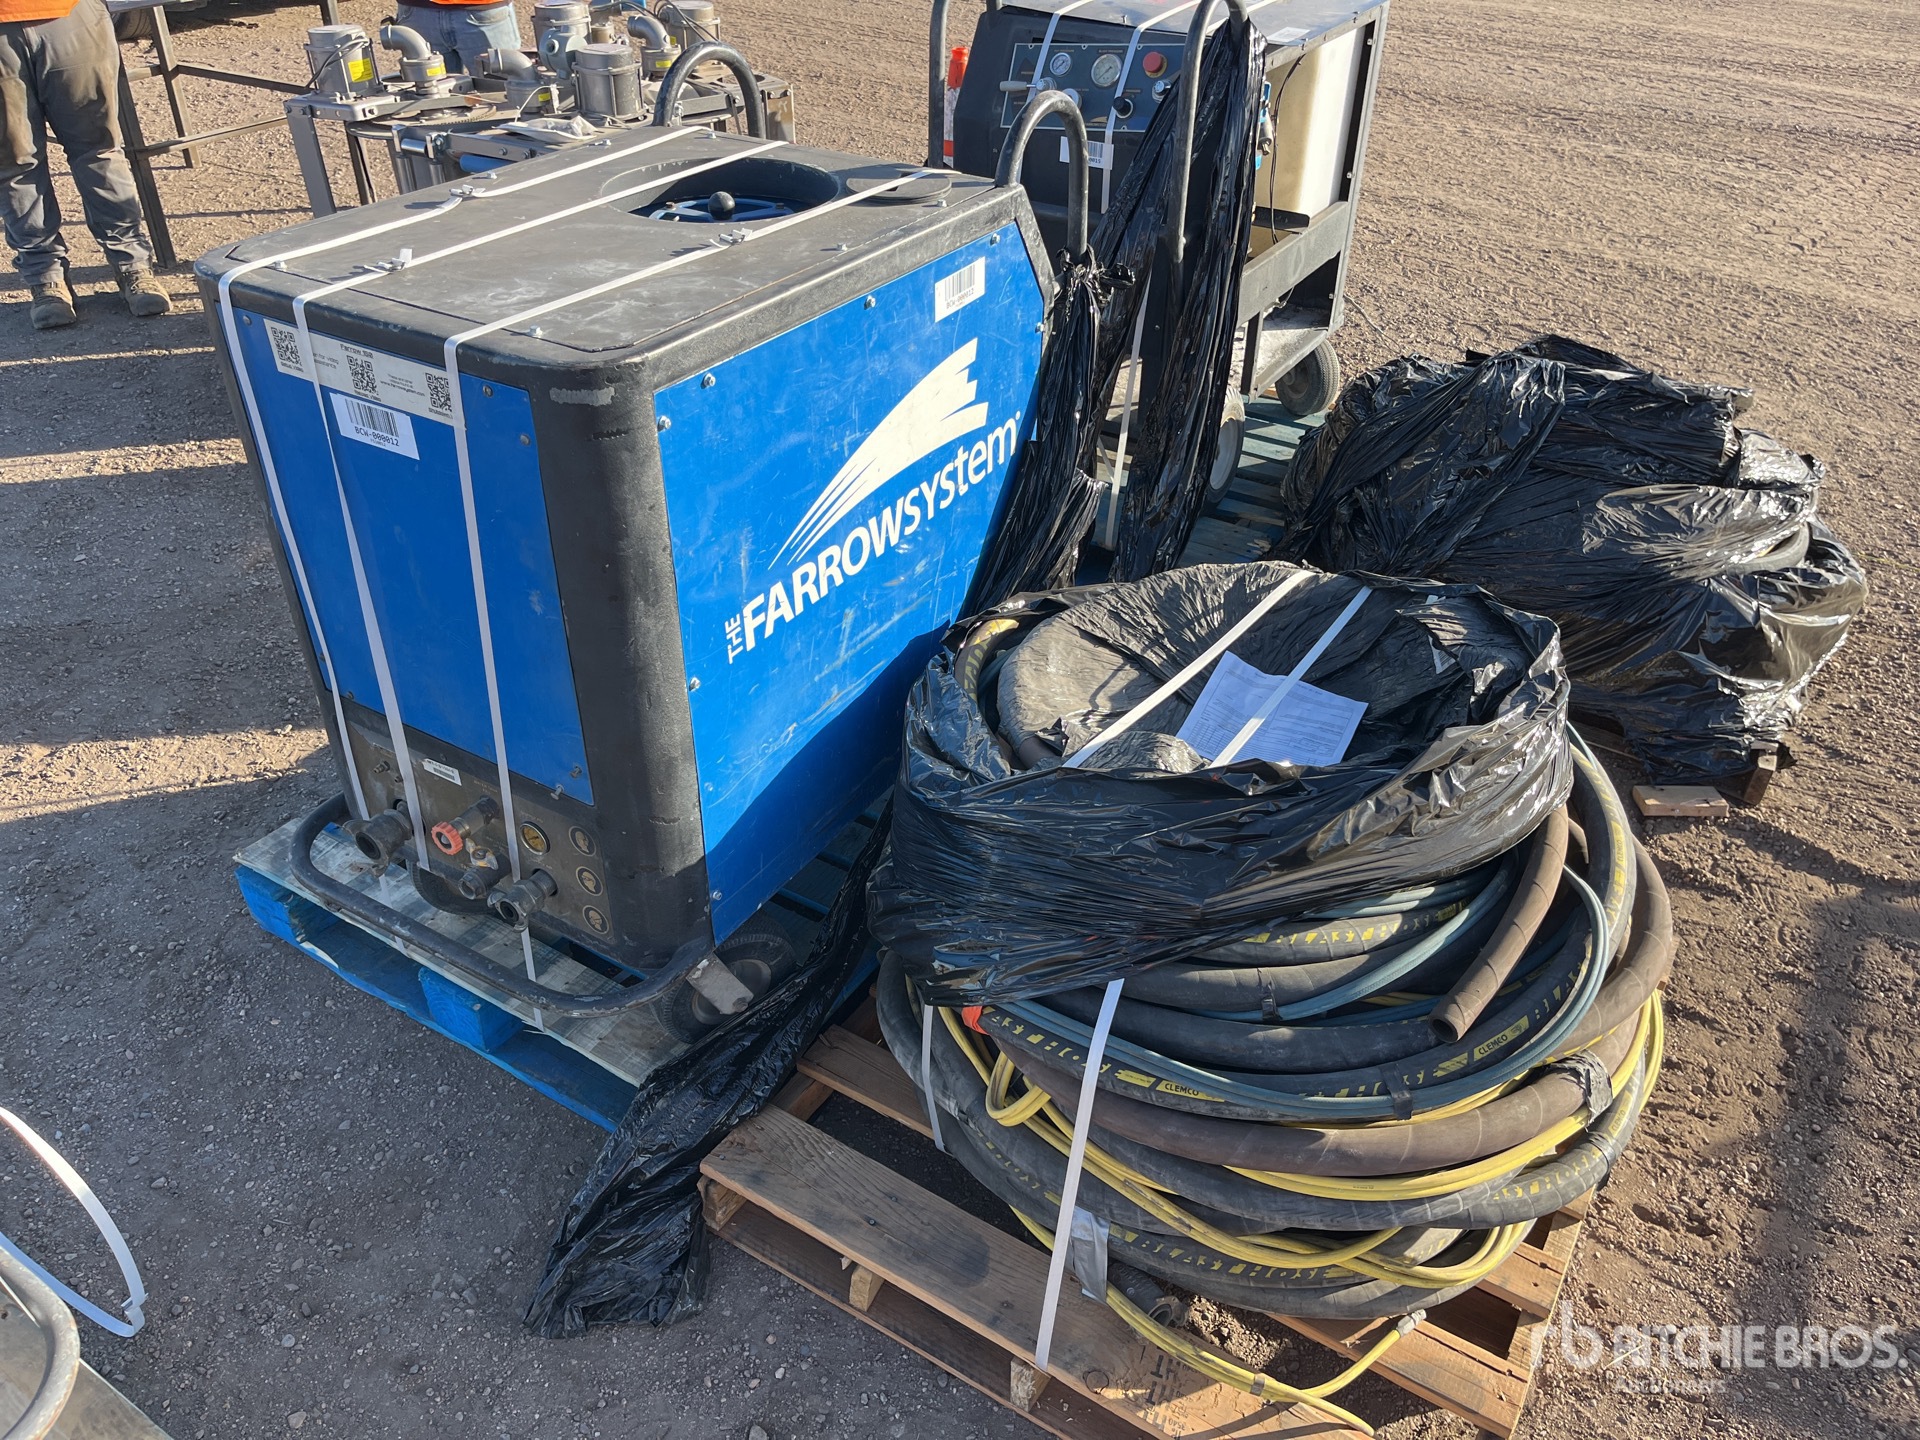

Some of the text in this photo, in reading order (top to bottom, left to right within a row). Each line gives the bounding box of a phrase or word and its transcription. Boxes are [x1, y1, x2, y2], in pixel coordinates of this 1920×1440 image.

[354, 425, 400, 447] BCW-000012
[724, 613, 744, 665] THE
[1478, 1033, 1508, 1055] CLEMCO
[1164, 1082, 1200, 1096] CLEMCO
